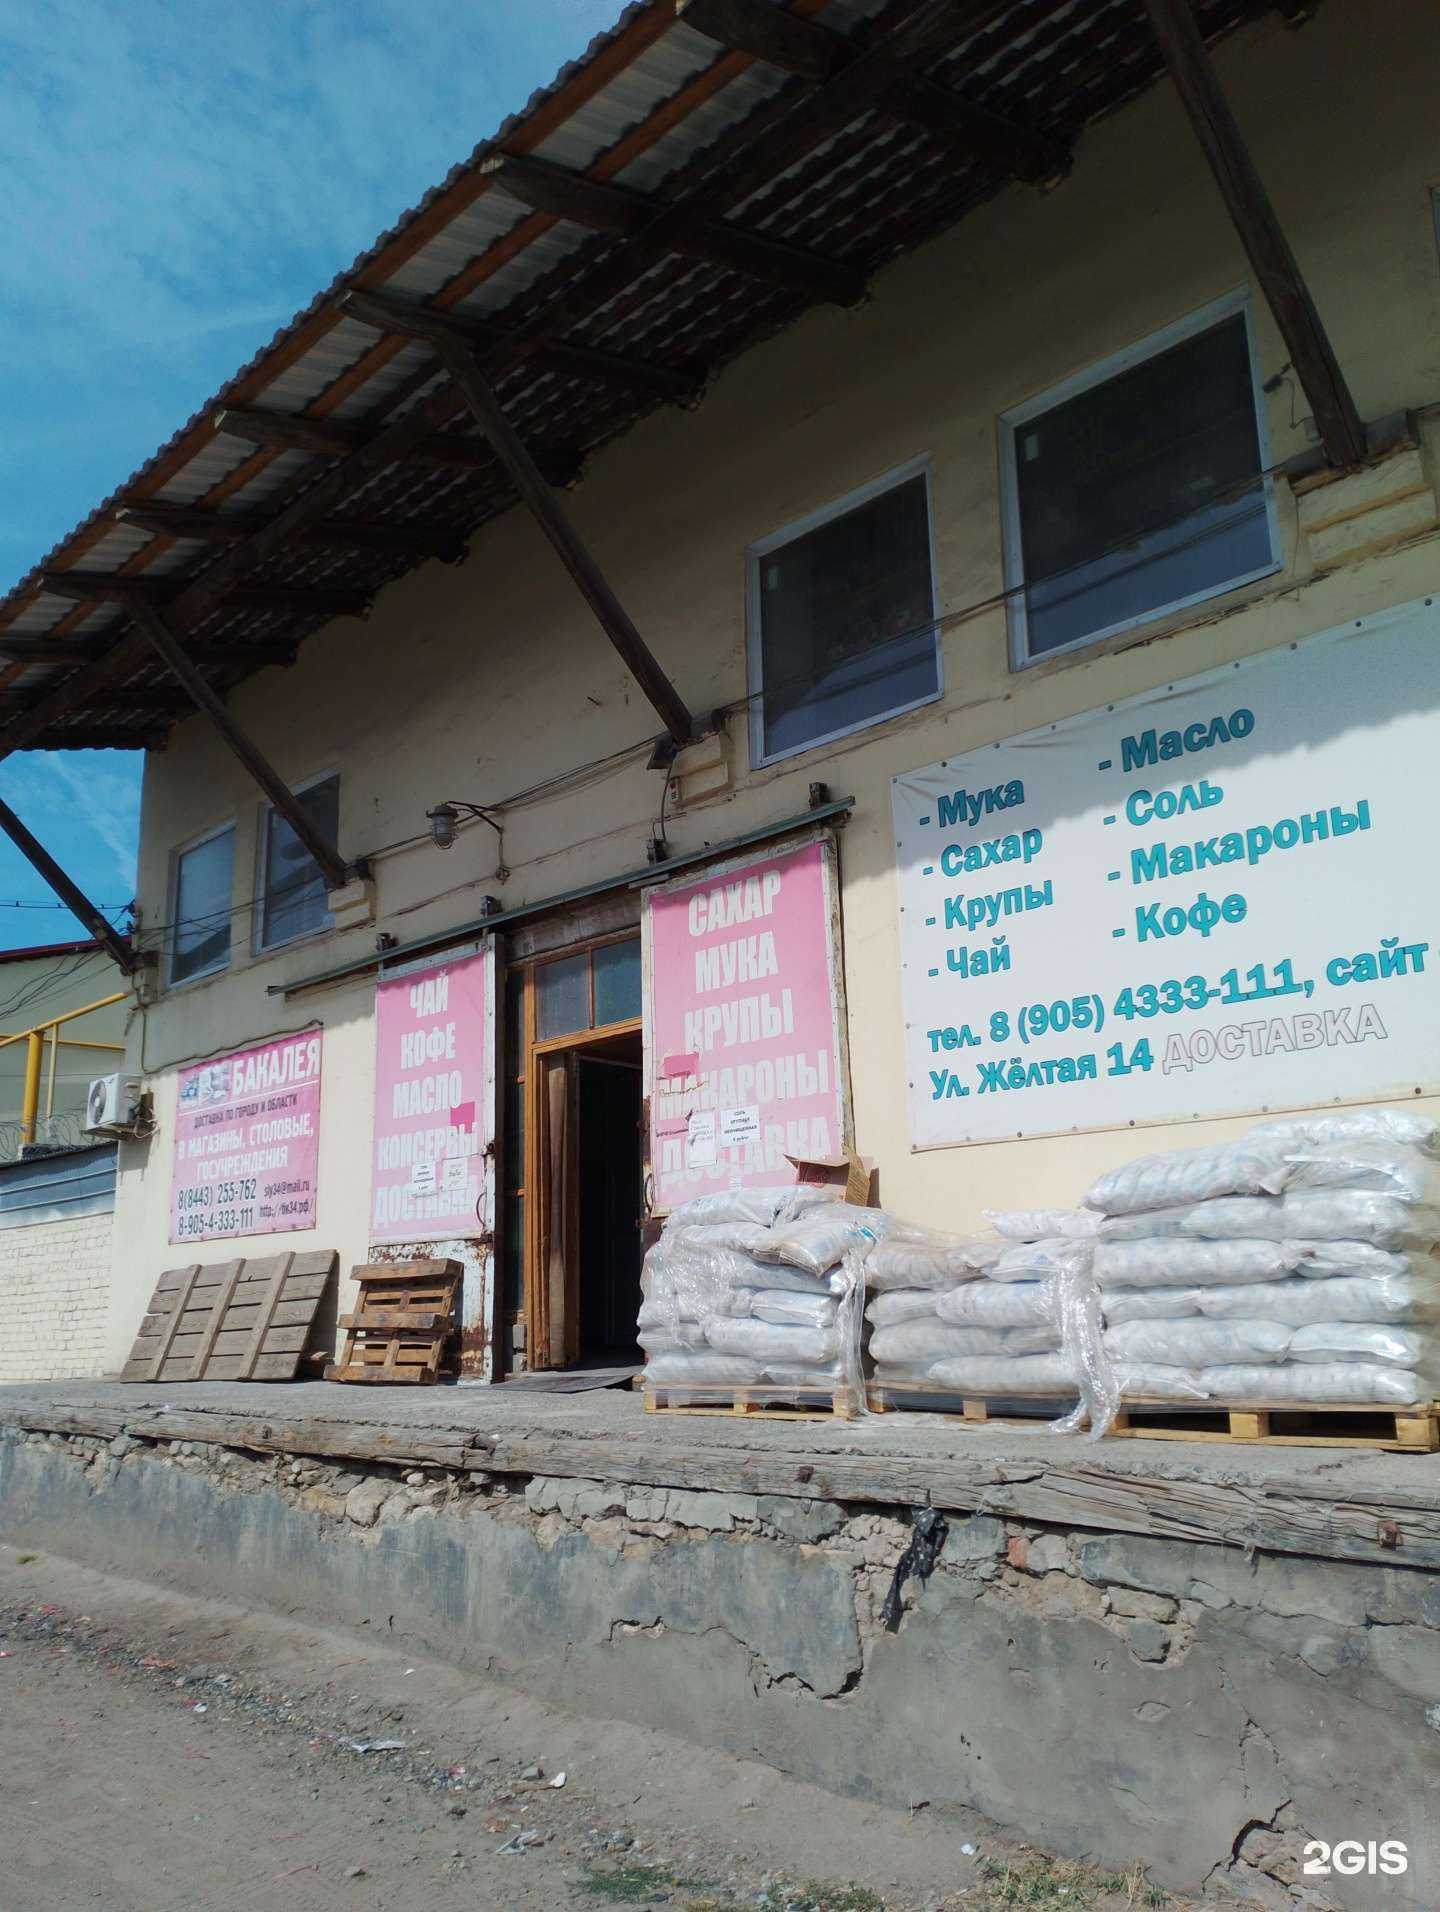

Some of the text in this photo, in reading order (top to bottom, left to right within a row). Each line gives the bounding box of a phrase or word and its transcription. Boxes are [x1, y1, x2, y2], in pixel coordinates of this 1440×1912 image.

[1121, 708, 1255, 772] Масло
[937, 779, 1025, 827] Мука
[1126, 780, 1224, 826] Соль
[941, 828, 1043, 876] Сахар
[1130, 800, 1371, 884] Макароны
[688, 870, 781, 937] САХАР
[944, 880, 1053, 931] Крупы
[1135, 892, 1248, 942] Кофе
[695, 931, 778, 994] МУКА
[946, 935, 1011, 979] Чай
[410, 968, 449, 1018] ЧАЙ
[927, 937, 1429, 1052] тел. 8 (905) 4333-111, сайт
[684, 988, 794, 1050] КРУПЫ
[232, 1038, 321, 1098] БАКАЛЕЯ
[401, 1022, 456, 1069] КОФЕ
[929, 1003, 1389, 1100] Ул. Жёлтая 14 ДОСТАВКА
[235, 1104, 259, 1118] ГОРОДУ
[267, 1093, 298, 1111] ОБЛАСТИ
[393, 1070, 463, 1119] МАСЛО
[178, 1140, 186, 1160] В
[250, 1112, 313, 1146] СТОЛОВЫЕ,
[197, 1146, 288, 1182] ГОСУЧРЕЖДЕНИЯ
[178, 1178, 257, 1211] 8(8443) 255-762
[178, 1207, 254, 1236] 8-905-4-333-111
